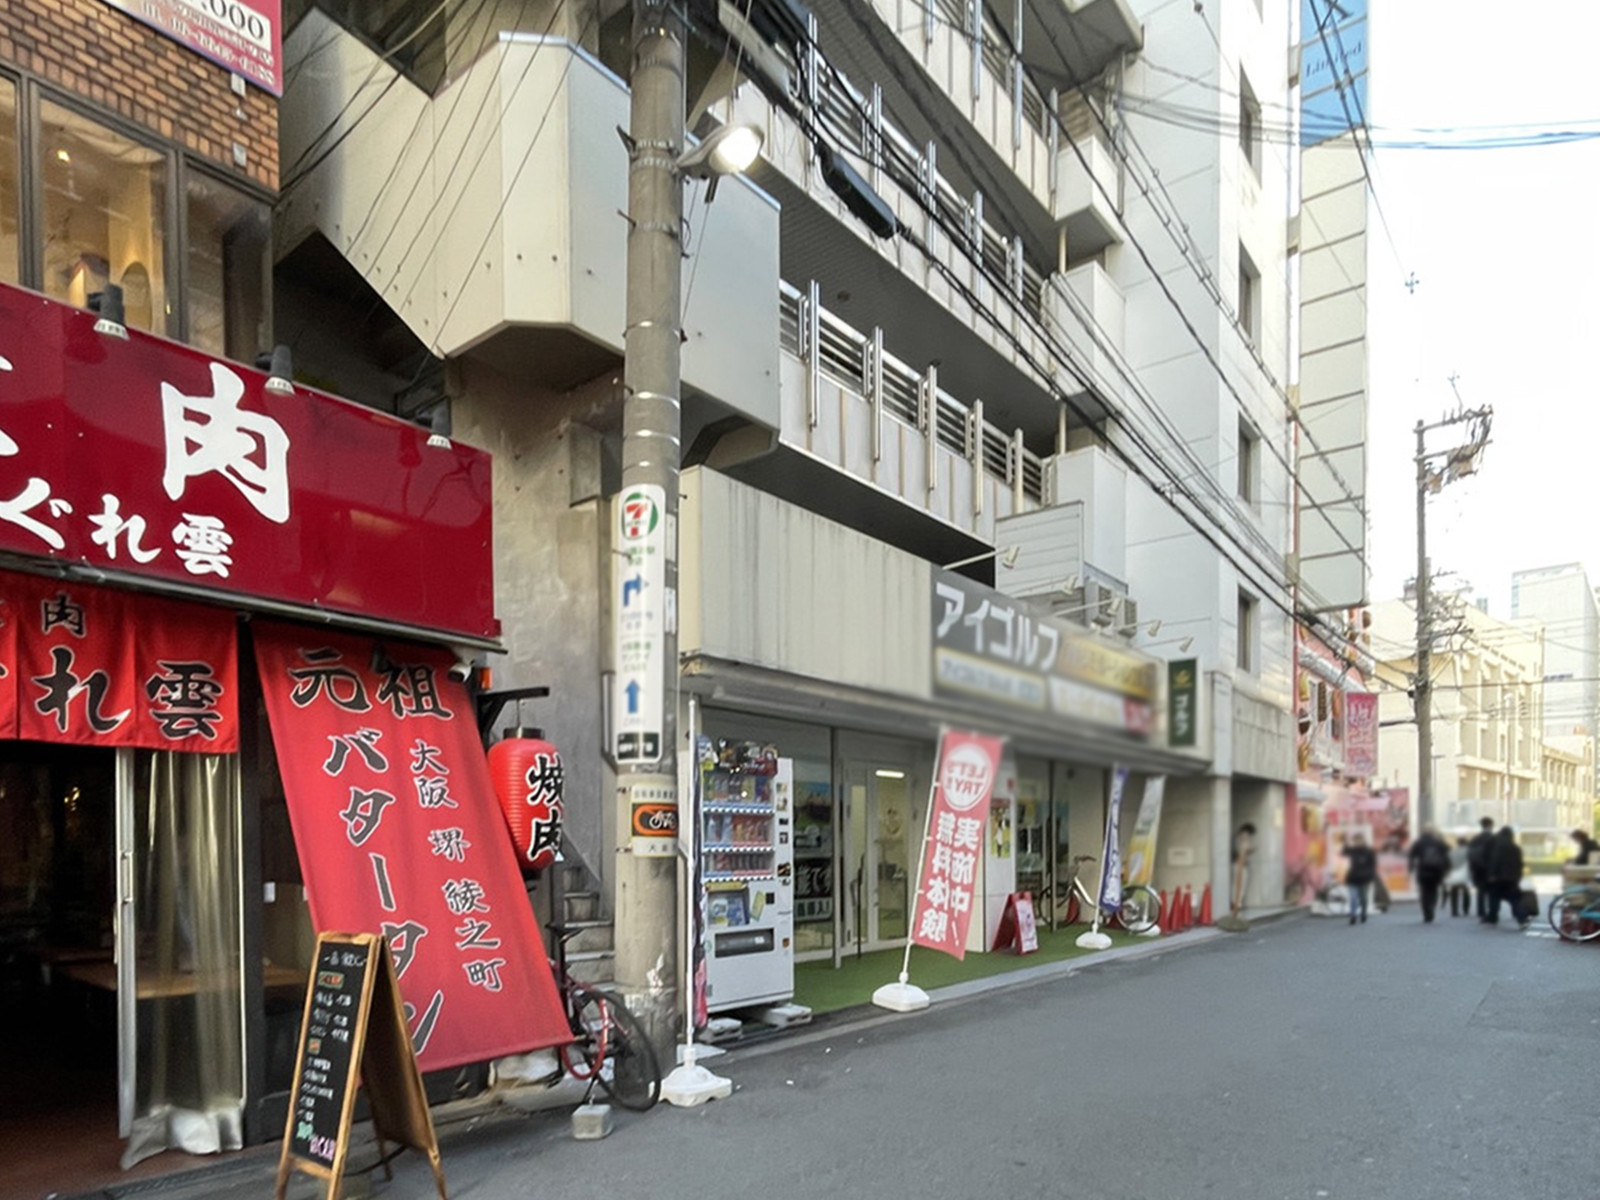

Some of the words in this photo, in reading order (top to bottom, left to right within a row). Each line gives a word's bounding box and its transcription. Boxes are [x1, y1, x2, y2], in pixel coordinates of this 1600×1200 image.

[936, 580, 1059, 672] アイゴルフ
[31, 645, 225, 741] れ雲
[287, 647, 456, 721] 元祖
[409, 739, 458, 809] 大阪
[428, 827, 472, 862] 堺
[441, 878, 507, 991] 綾之町
